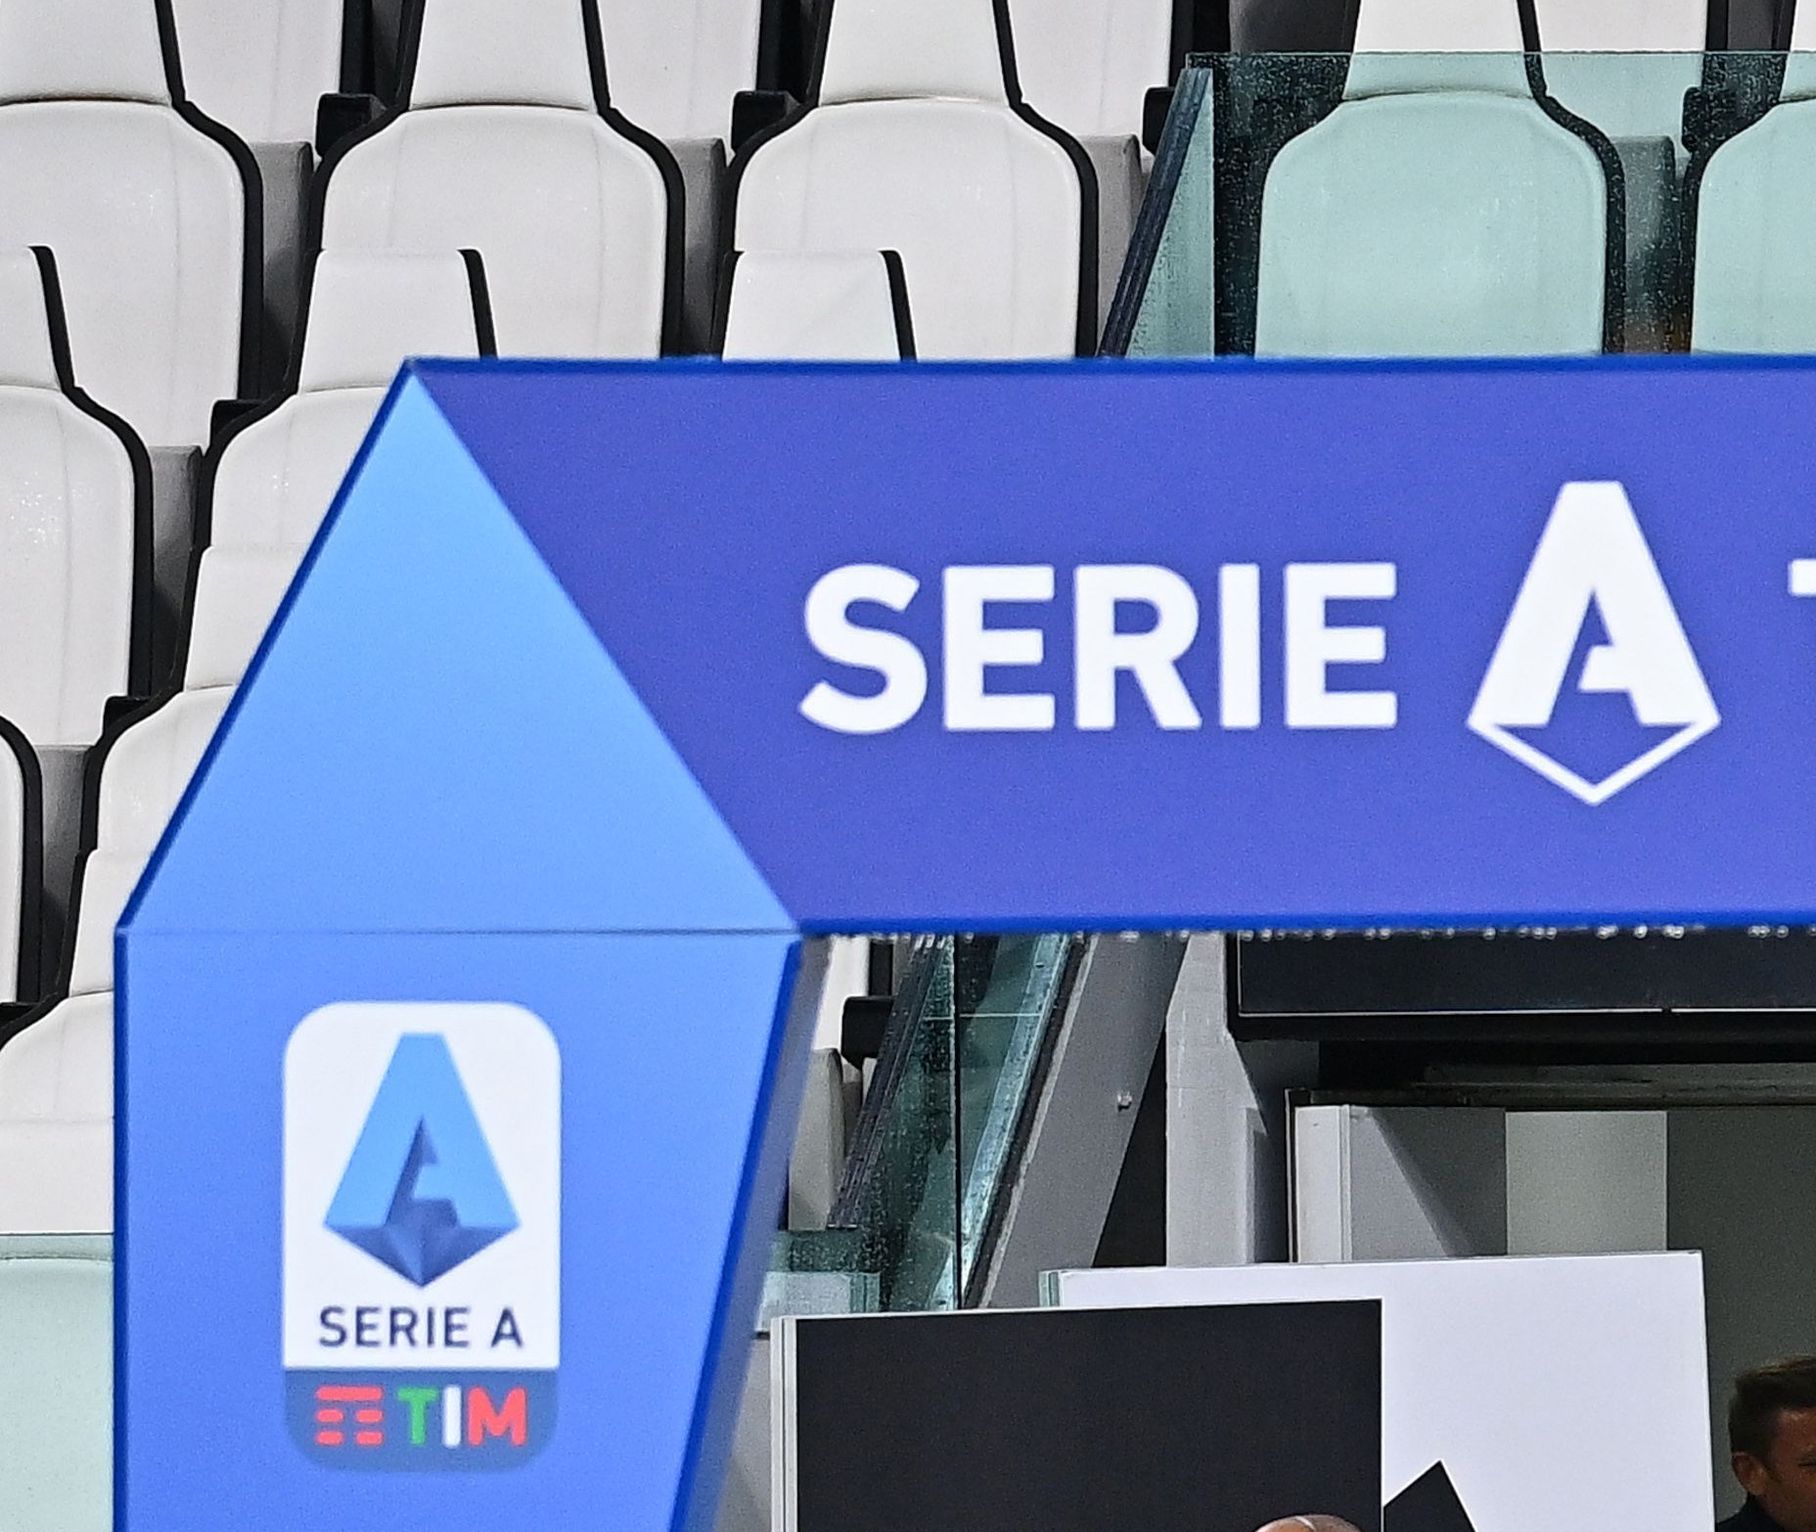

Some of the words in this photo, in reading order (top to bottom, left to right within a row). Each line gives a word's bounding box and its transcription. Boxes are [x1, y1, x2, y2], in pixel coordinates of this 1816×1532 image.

[800, 561, 1397, 734] SERIE
[318, 1306, 470, 1349] SERIE
[491, 1307, 523, 1348] A
[397, 1384, 527, 1448] TIM
